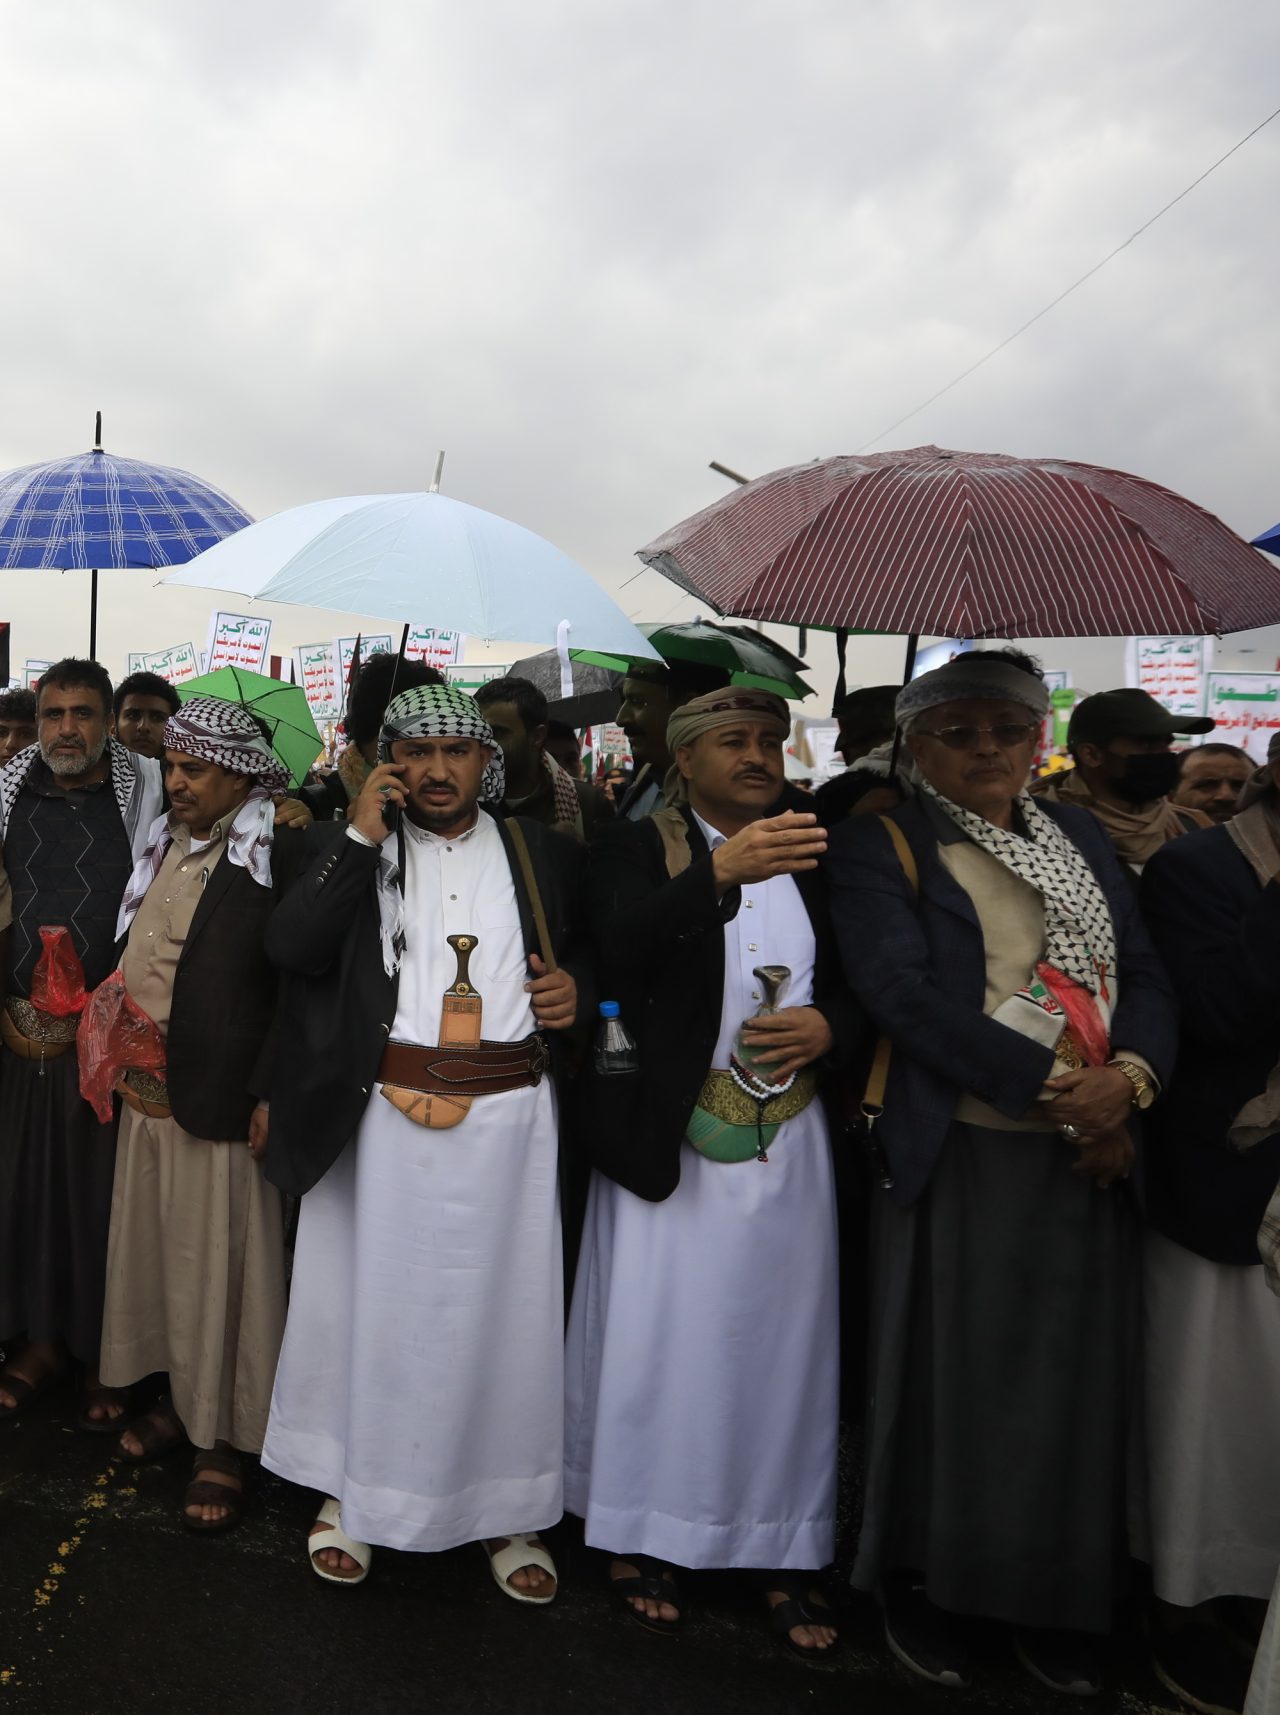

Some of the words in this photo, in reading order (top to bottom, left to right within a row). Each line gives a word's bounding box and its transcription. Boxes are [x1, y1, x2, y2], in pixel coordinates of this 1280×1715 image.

[218, 619, 249, 636] أكبر
[248, 623, 268, 637] الله
[215, 635, 242, 648] لأمريكا
[438, 630, 458, 641] الله
[242, 639, 263, 652] الموت
[434, 645, 455, 657] الموت
[176, 647, 192, 664] الله
[240, 653, 261, 665] الموت
[303, 648, 328, 667] أكبر
